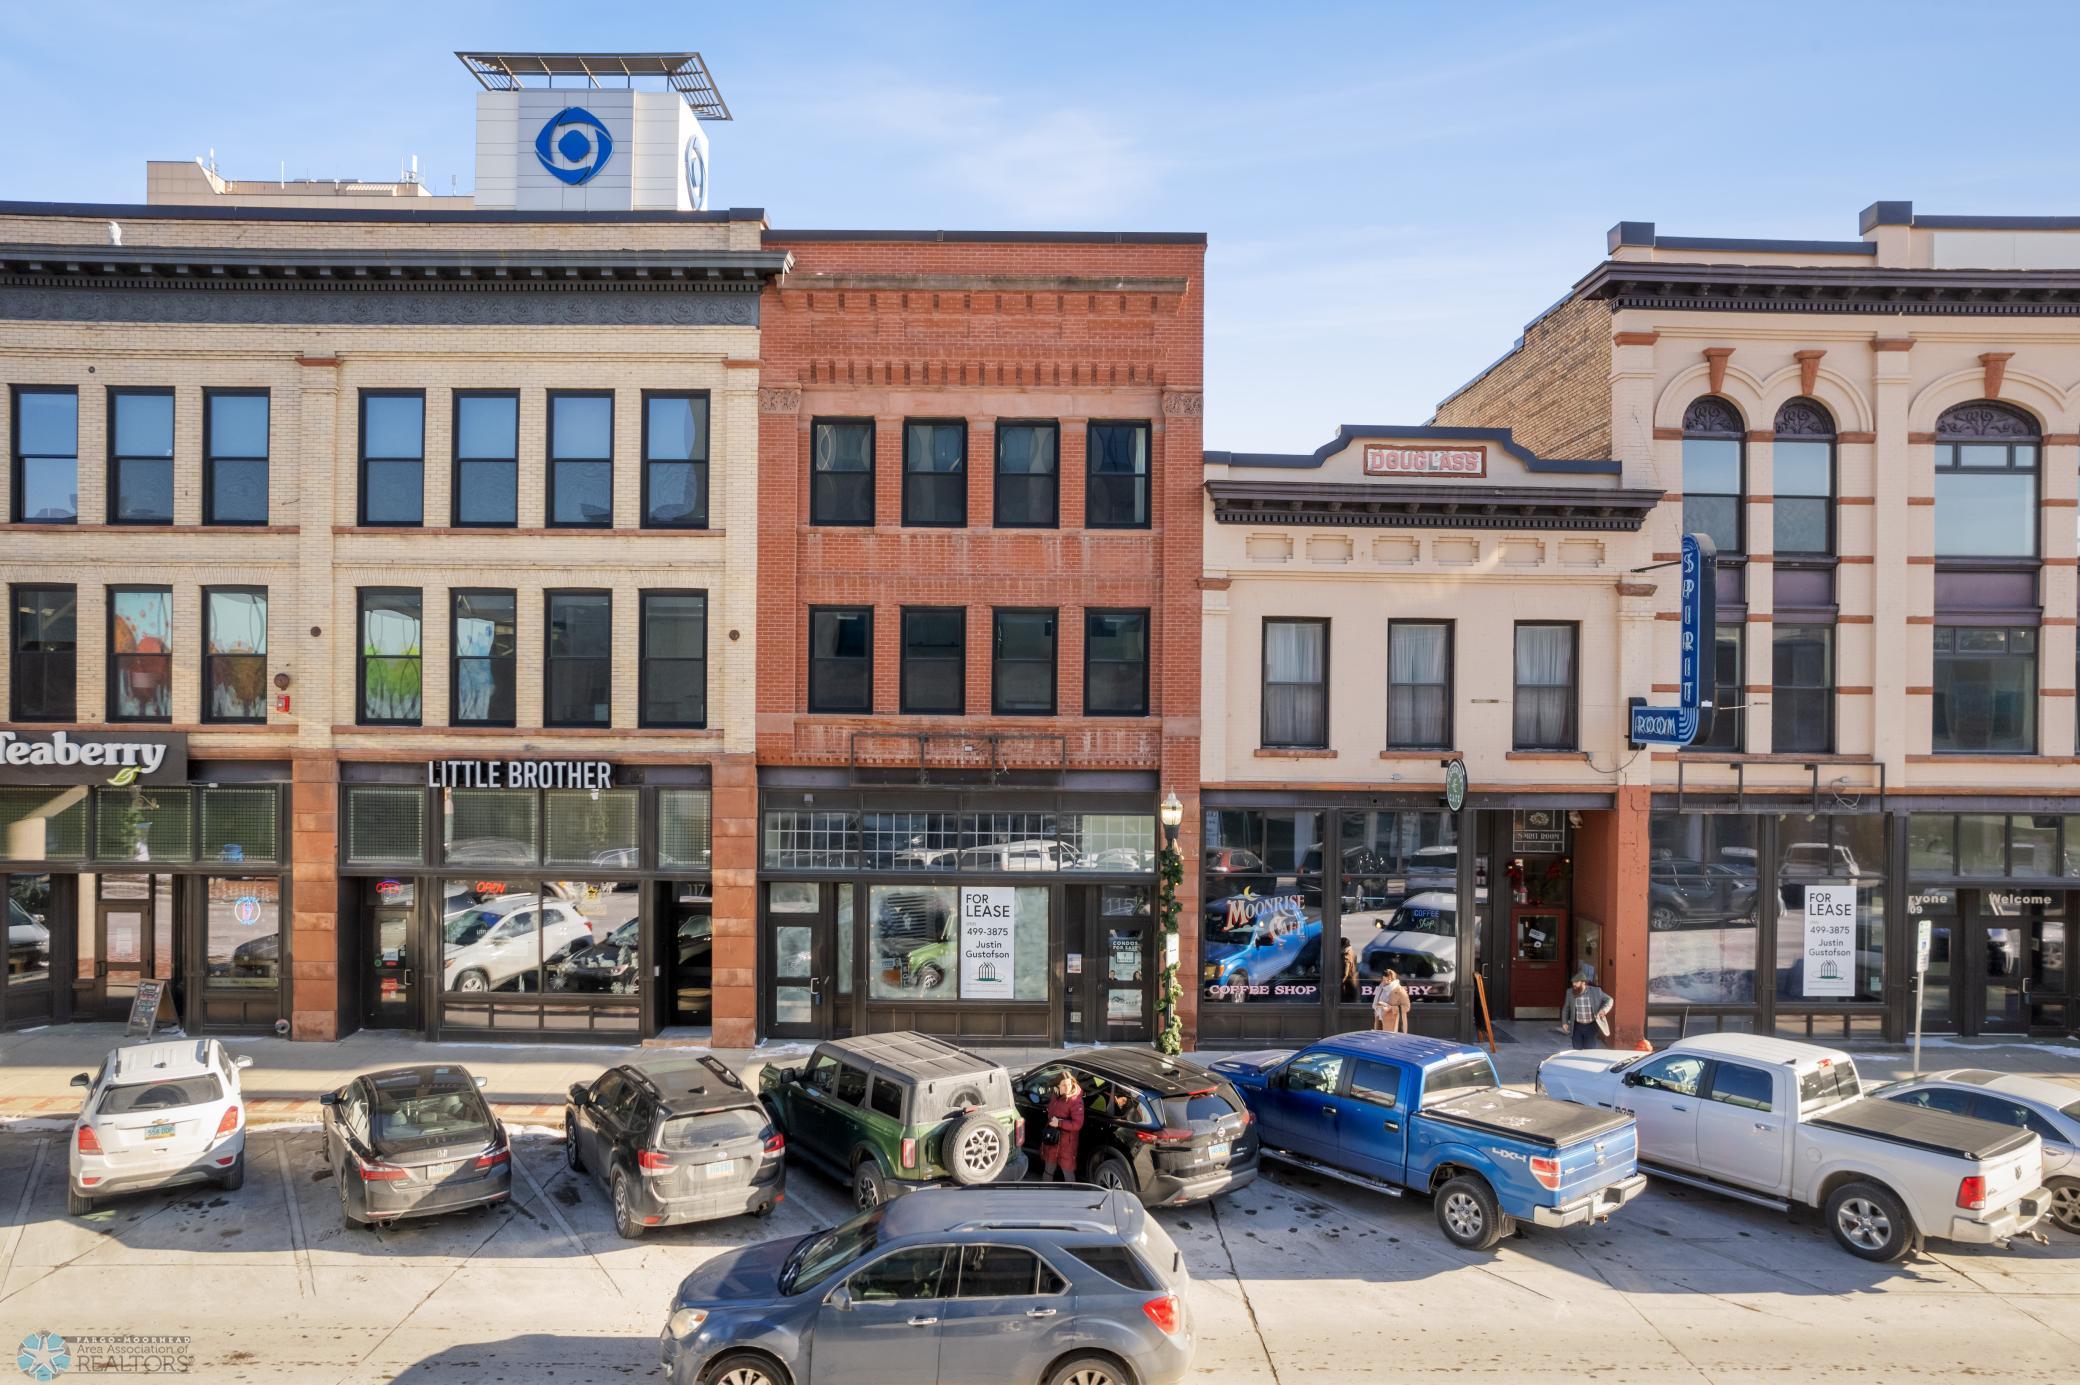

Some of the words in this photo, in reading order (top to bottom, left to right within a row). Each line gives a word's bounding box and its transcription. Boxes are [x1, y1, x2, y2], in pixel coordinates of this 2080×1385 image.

[1371, 451, 1478, 471] DOUGLASS
[1682, 552, 1694, 702] SPIRIT
[1634, 715, 1677, 736] ROOM
[0, 731, 166, 774] Teaberry
[428, 761, 501, 788] LITTLE
[508, 761, 611, 789] BROTHER
[476, 881, 505, 894] OPEN
[966, 894, 988, 904] FOR
[1809, 893, 1831, 903] FOR
[1988, 893, 2052, 905] Welcome
[966, 905, 1010, 918] LEASE
[1414, 909, 1440, 918] COFFEE
[1809, 904, 1852, 916] LEASE
[967, 928, 1009, 936] 499-3875
[1810, 926, 1850, 935] 499-3875
[976, 940, 1002, 949] Justin
[1818, 939, 1844, 947] Justin
[965, 950, 1010, 958] Gustofson
[1808, 948, 1851, 957] Gustofson
[1209, 985, 1270, 995] COFFEE
[1274, 985, 1317, 995] SHOP
